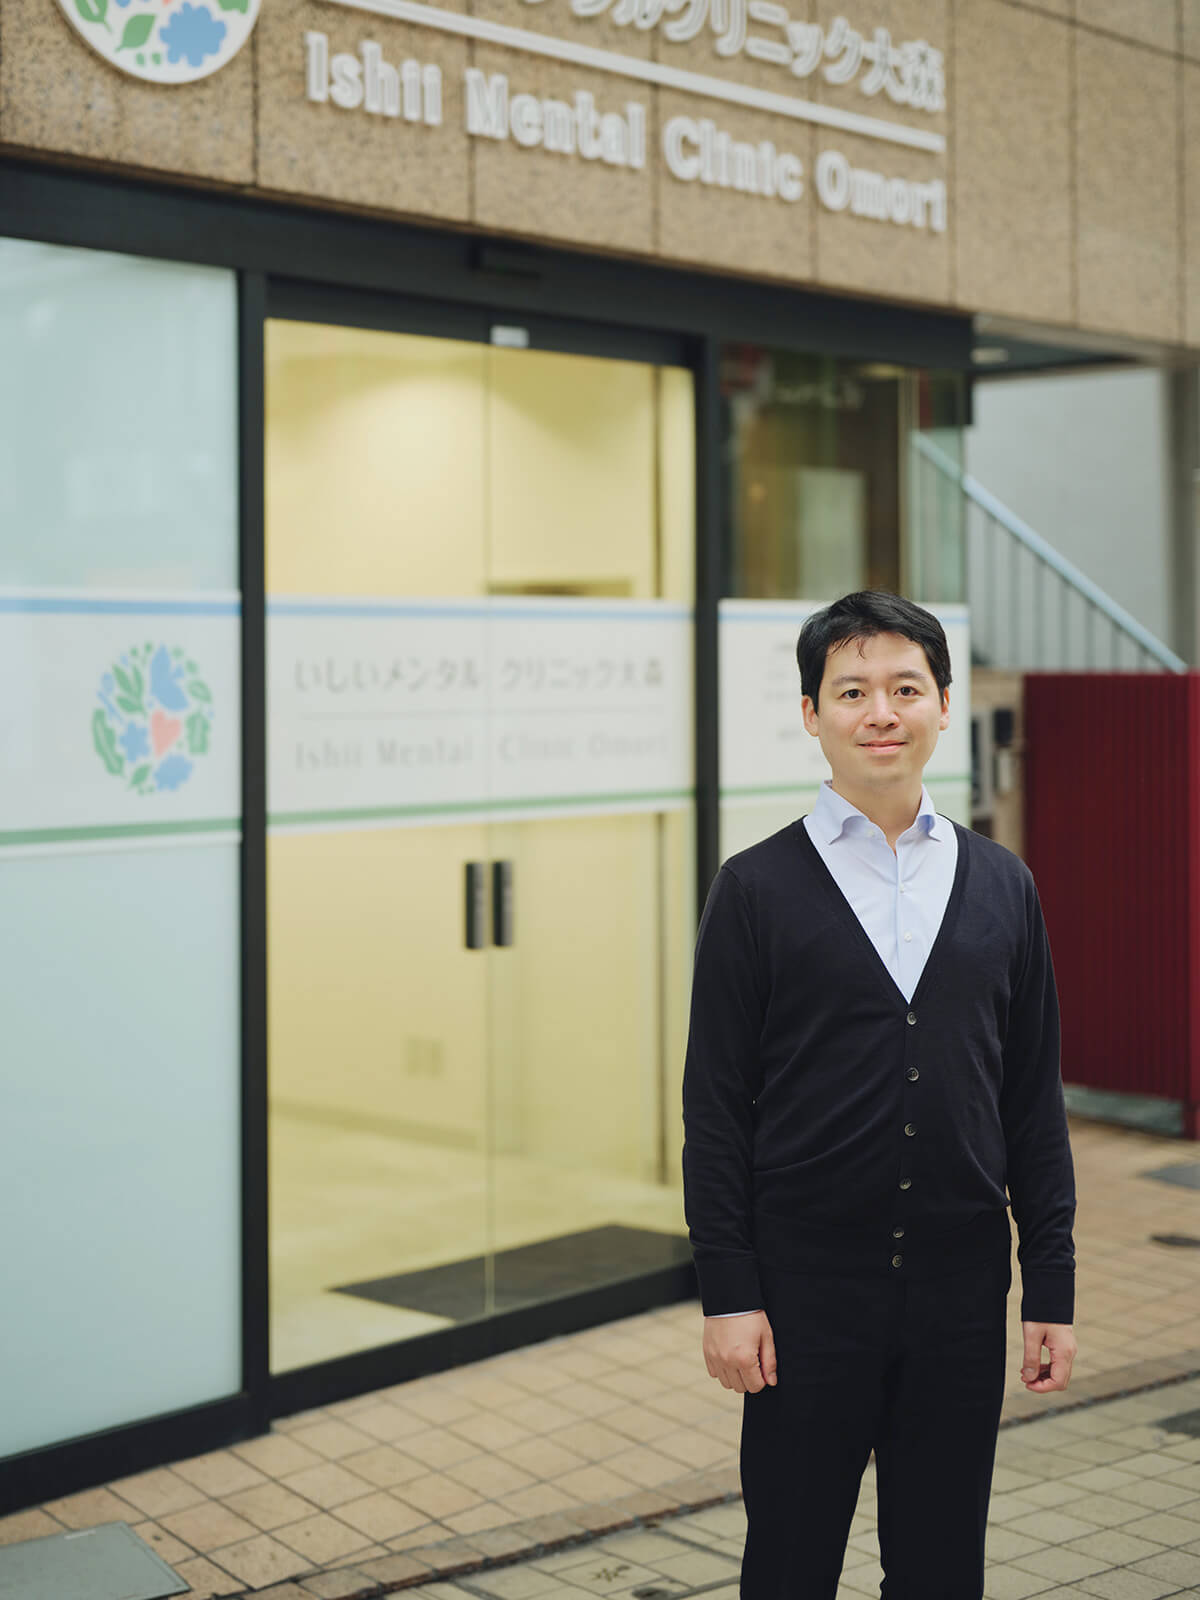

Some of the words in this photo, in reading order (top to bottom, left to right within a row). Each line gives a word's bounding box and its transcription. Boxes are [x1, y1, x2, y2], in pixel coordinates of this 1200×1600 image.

[306, 31, 443, 126] Ishii
[465, 67, 647, 168] Mental
[662, 115, 803, 200] Clinic
[815, 150, 948, 232] Omori
[527, 0, 948, 113] クリニック大森
